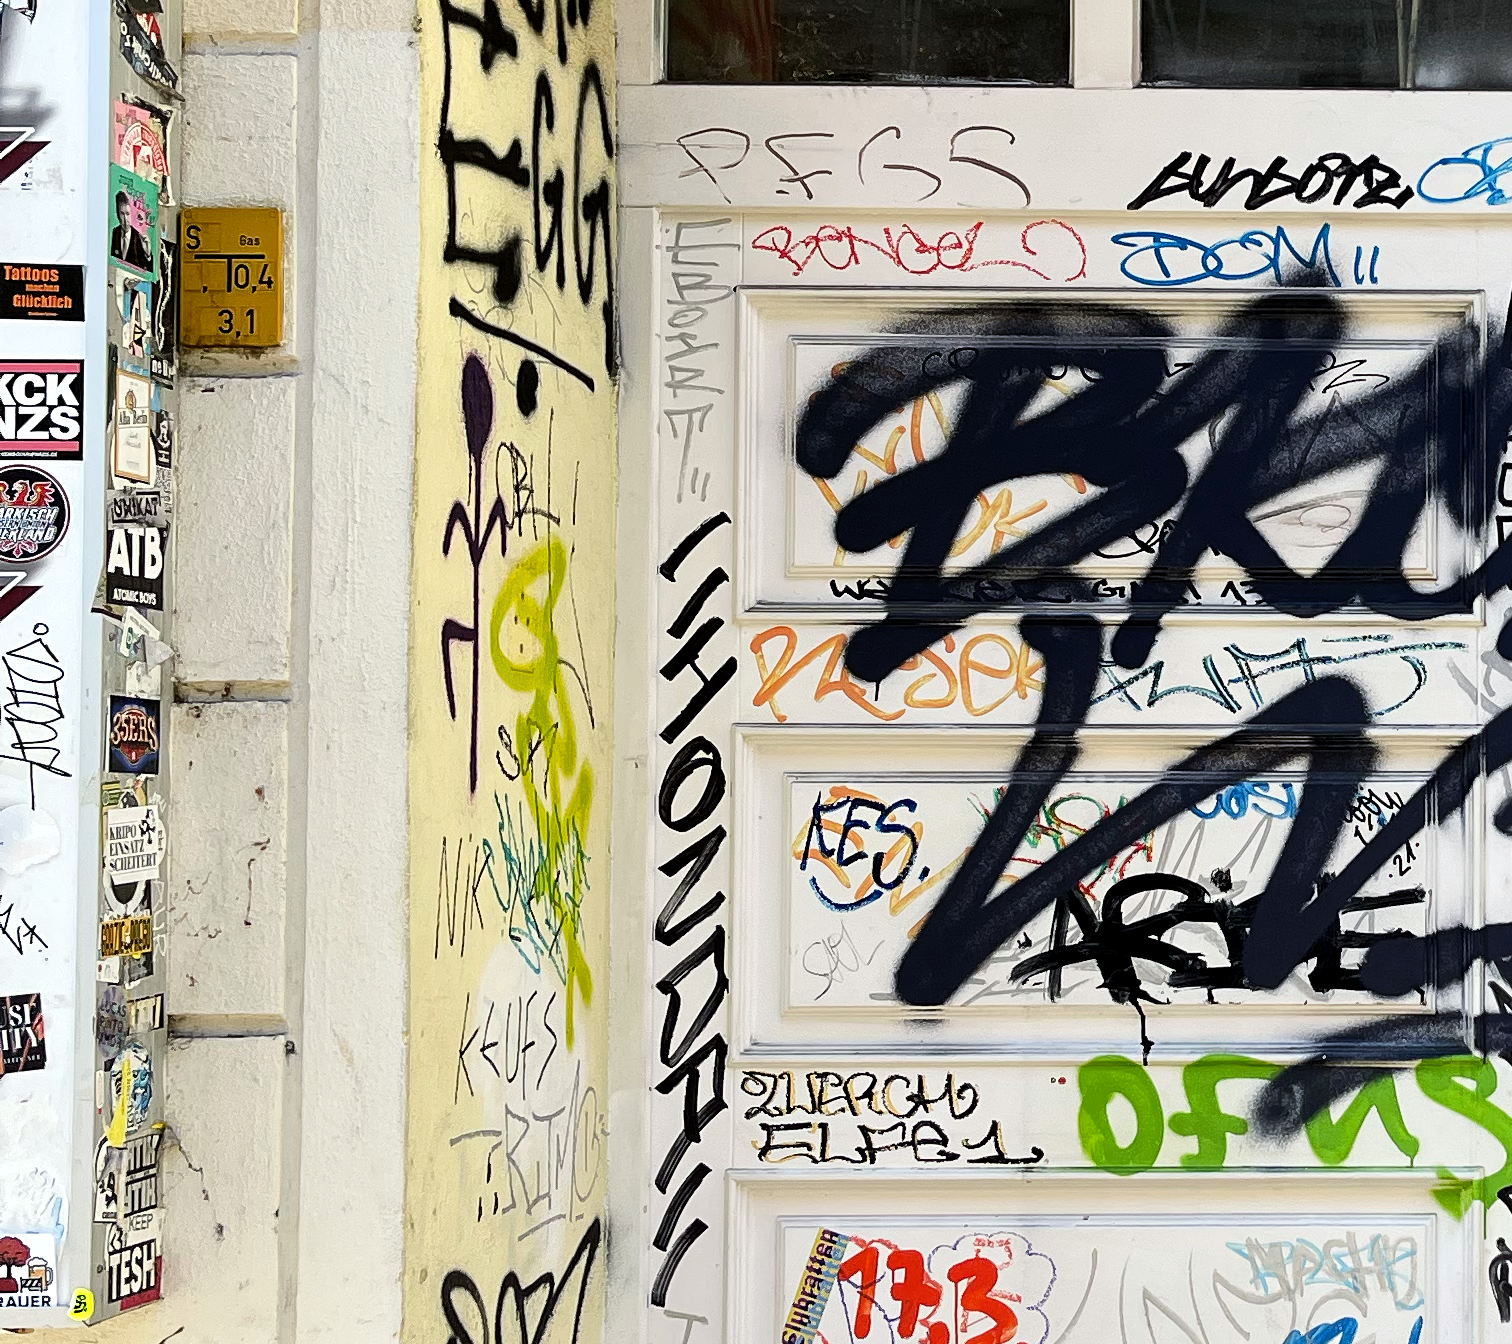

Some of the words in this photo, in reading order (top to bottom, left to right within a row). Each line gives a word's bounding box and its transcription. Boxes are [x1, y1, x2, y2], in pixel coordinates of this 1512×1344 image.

[186, 225, 201, 250] S
[239, 234, 260, 246] Gas
[3, 265, 60, 282] Tattoos
[107, 527, 163, 580] ATB
[109, 824, 137, 841] KRIPO
[109, 838, 145, 856] EINSATZ
[109, 1244, 156, 1300] TESH
